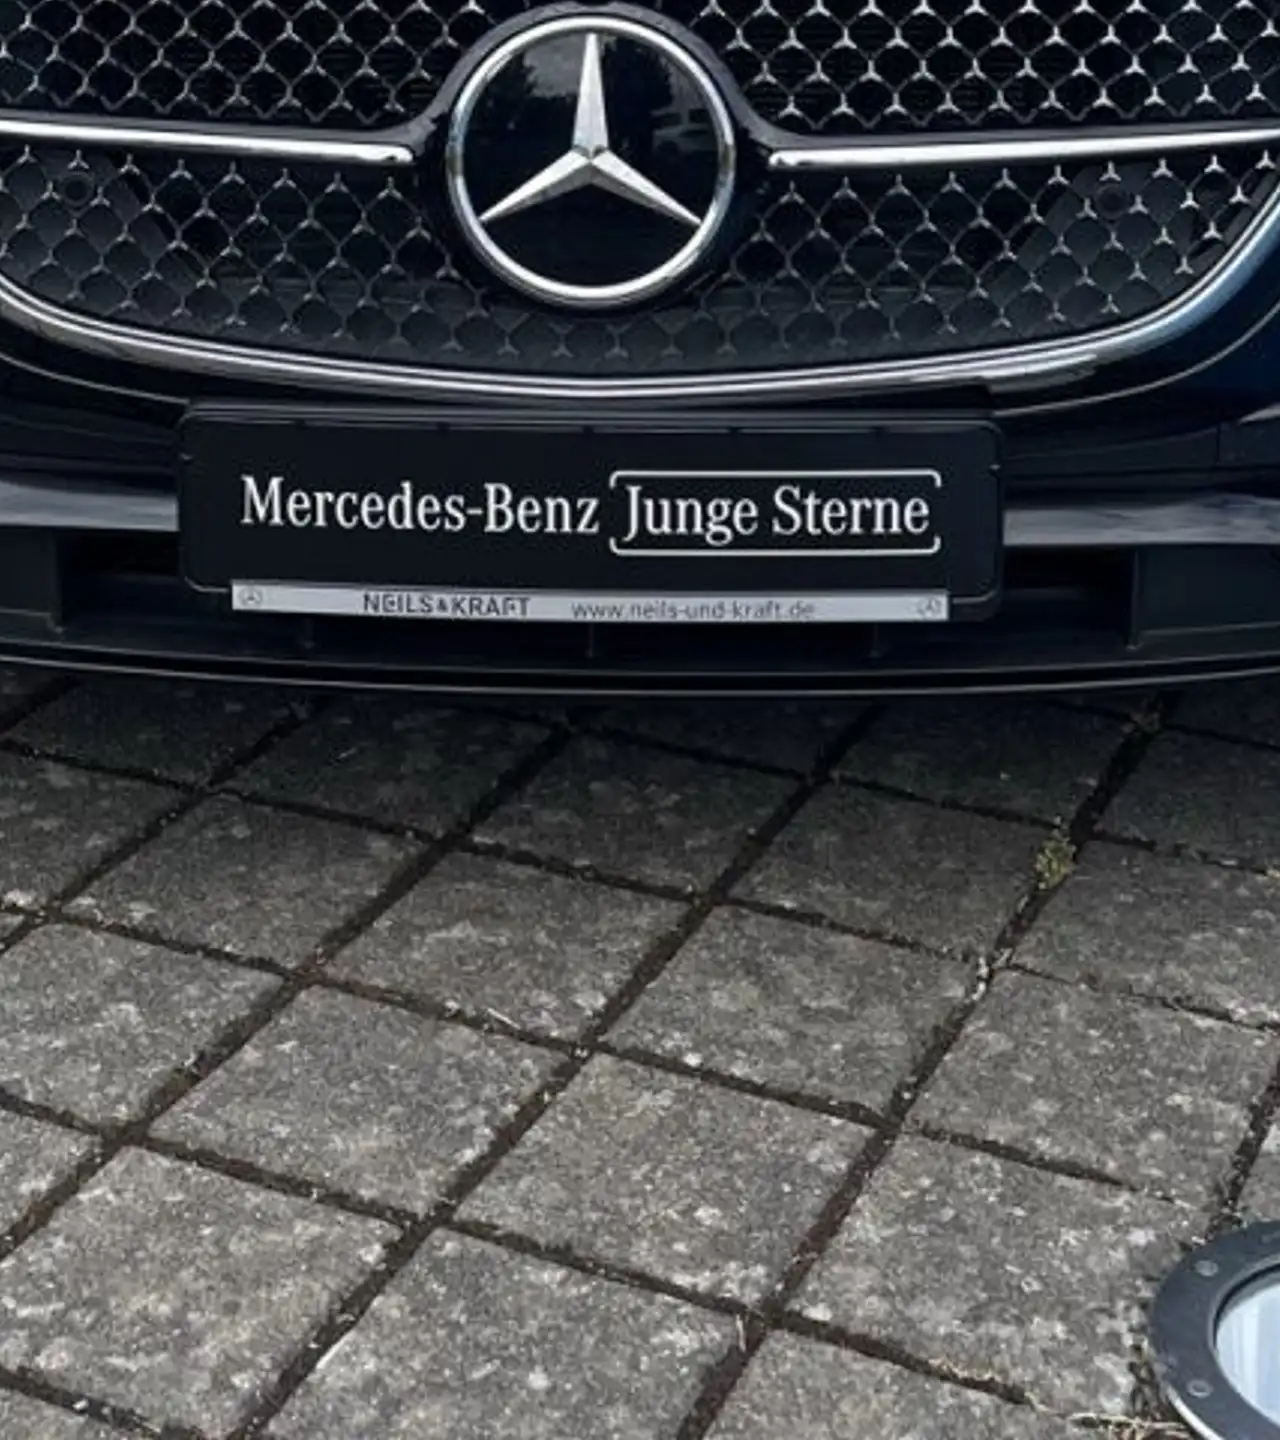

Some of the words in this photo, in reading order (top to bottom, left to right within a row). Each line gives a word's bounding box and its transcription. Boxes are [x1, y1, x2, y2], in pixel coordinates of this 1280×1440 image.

[240, 475, 599, 534] Mercedes-Benz
[623, 484, 759, 546] Junge
[771, 485, 931, 537] Sterne
[571, 599, 815, 621] www.neils-und-kraft.de
